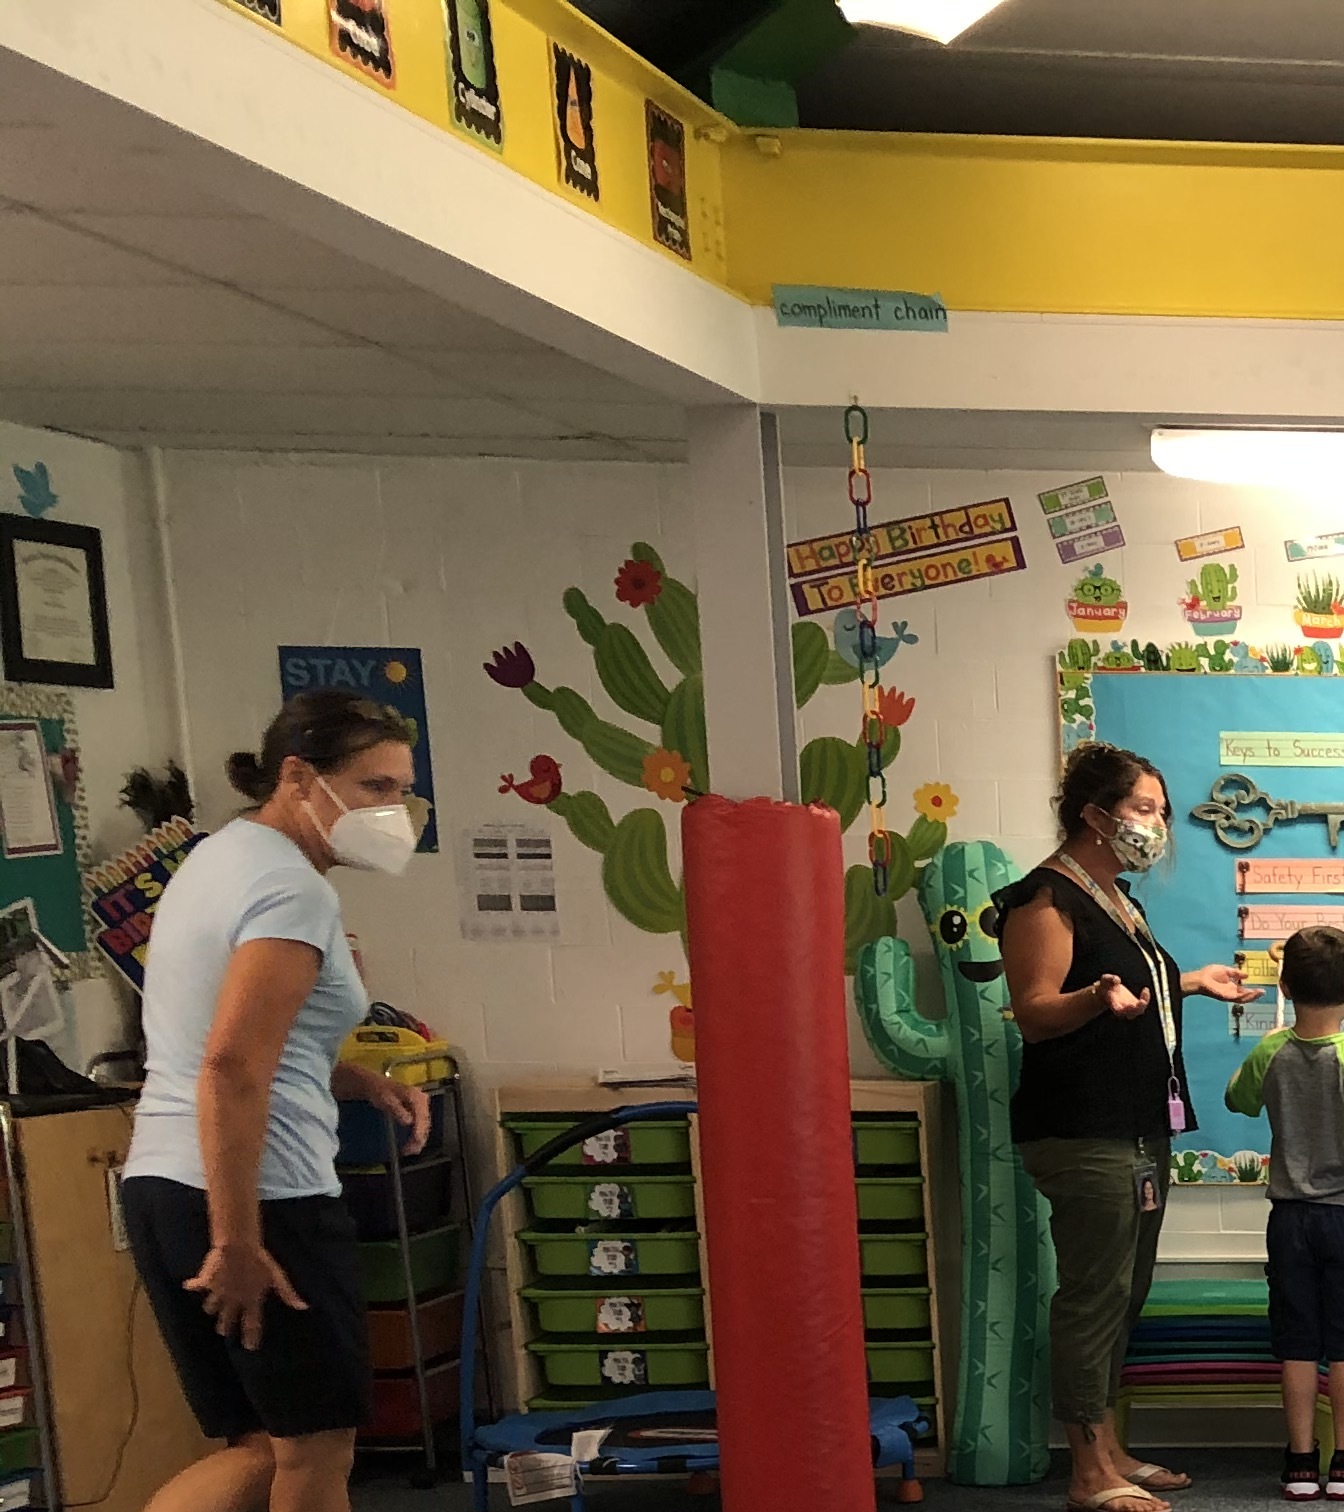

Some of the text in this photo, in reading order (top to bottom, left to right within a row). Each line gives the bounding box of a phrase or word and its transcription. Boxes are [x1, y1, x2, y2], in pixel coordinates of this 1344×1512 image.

[780, 297, 948, 326] compliment chain
[795, 508, 1005, 569] Happy Birthday
[811, 581, 845, 608] To
[1068, 603, 1127, 621] January
[1184, 605, 1241, 621] February
[1301, 611, 1342, 628] March
[284, 658, 377, 689] STAY
[1225, 739, 1255, 763] Keys
[1267, 739, 1280, 758] to
[1252, 867, 1304, 890] Safety
[1250, 913, 1270, 931] Do
[1275, 913, 1307, 931] Your
